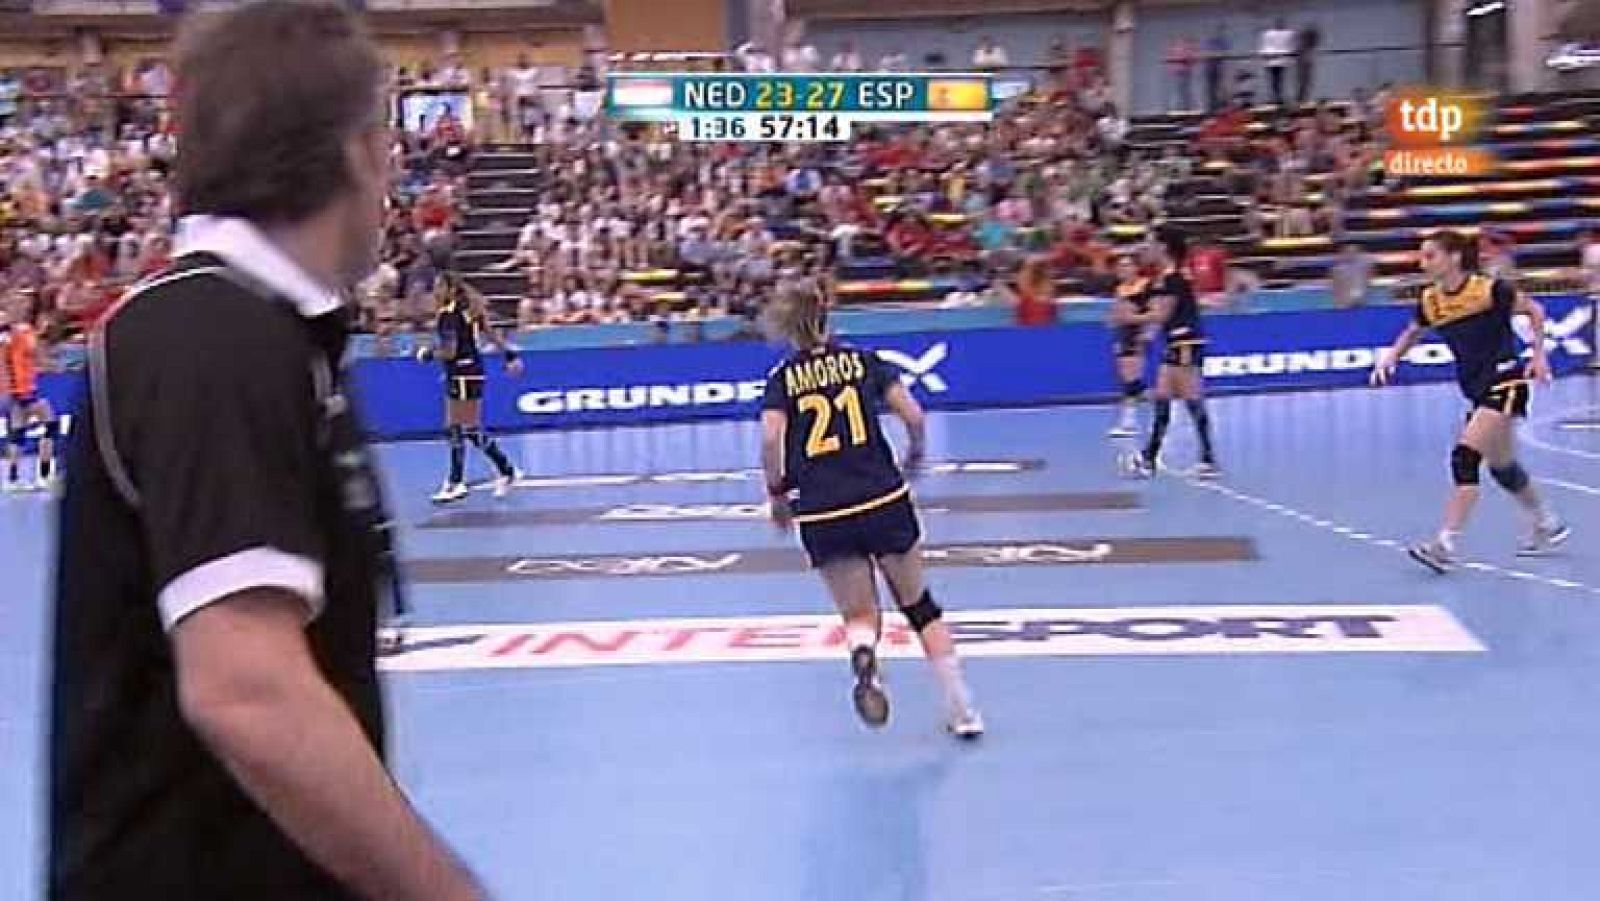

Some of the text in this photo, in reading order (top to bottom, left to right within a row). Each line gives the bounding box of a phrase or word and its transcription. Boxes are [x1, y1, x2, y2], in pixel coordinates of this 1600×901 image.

[518, 380, 768, 414] GRUNDF
[785, 352, 863, 397] AMOROS
[798, 386, 867, 457] 21
